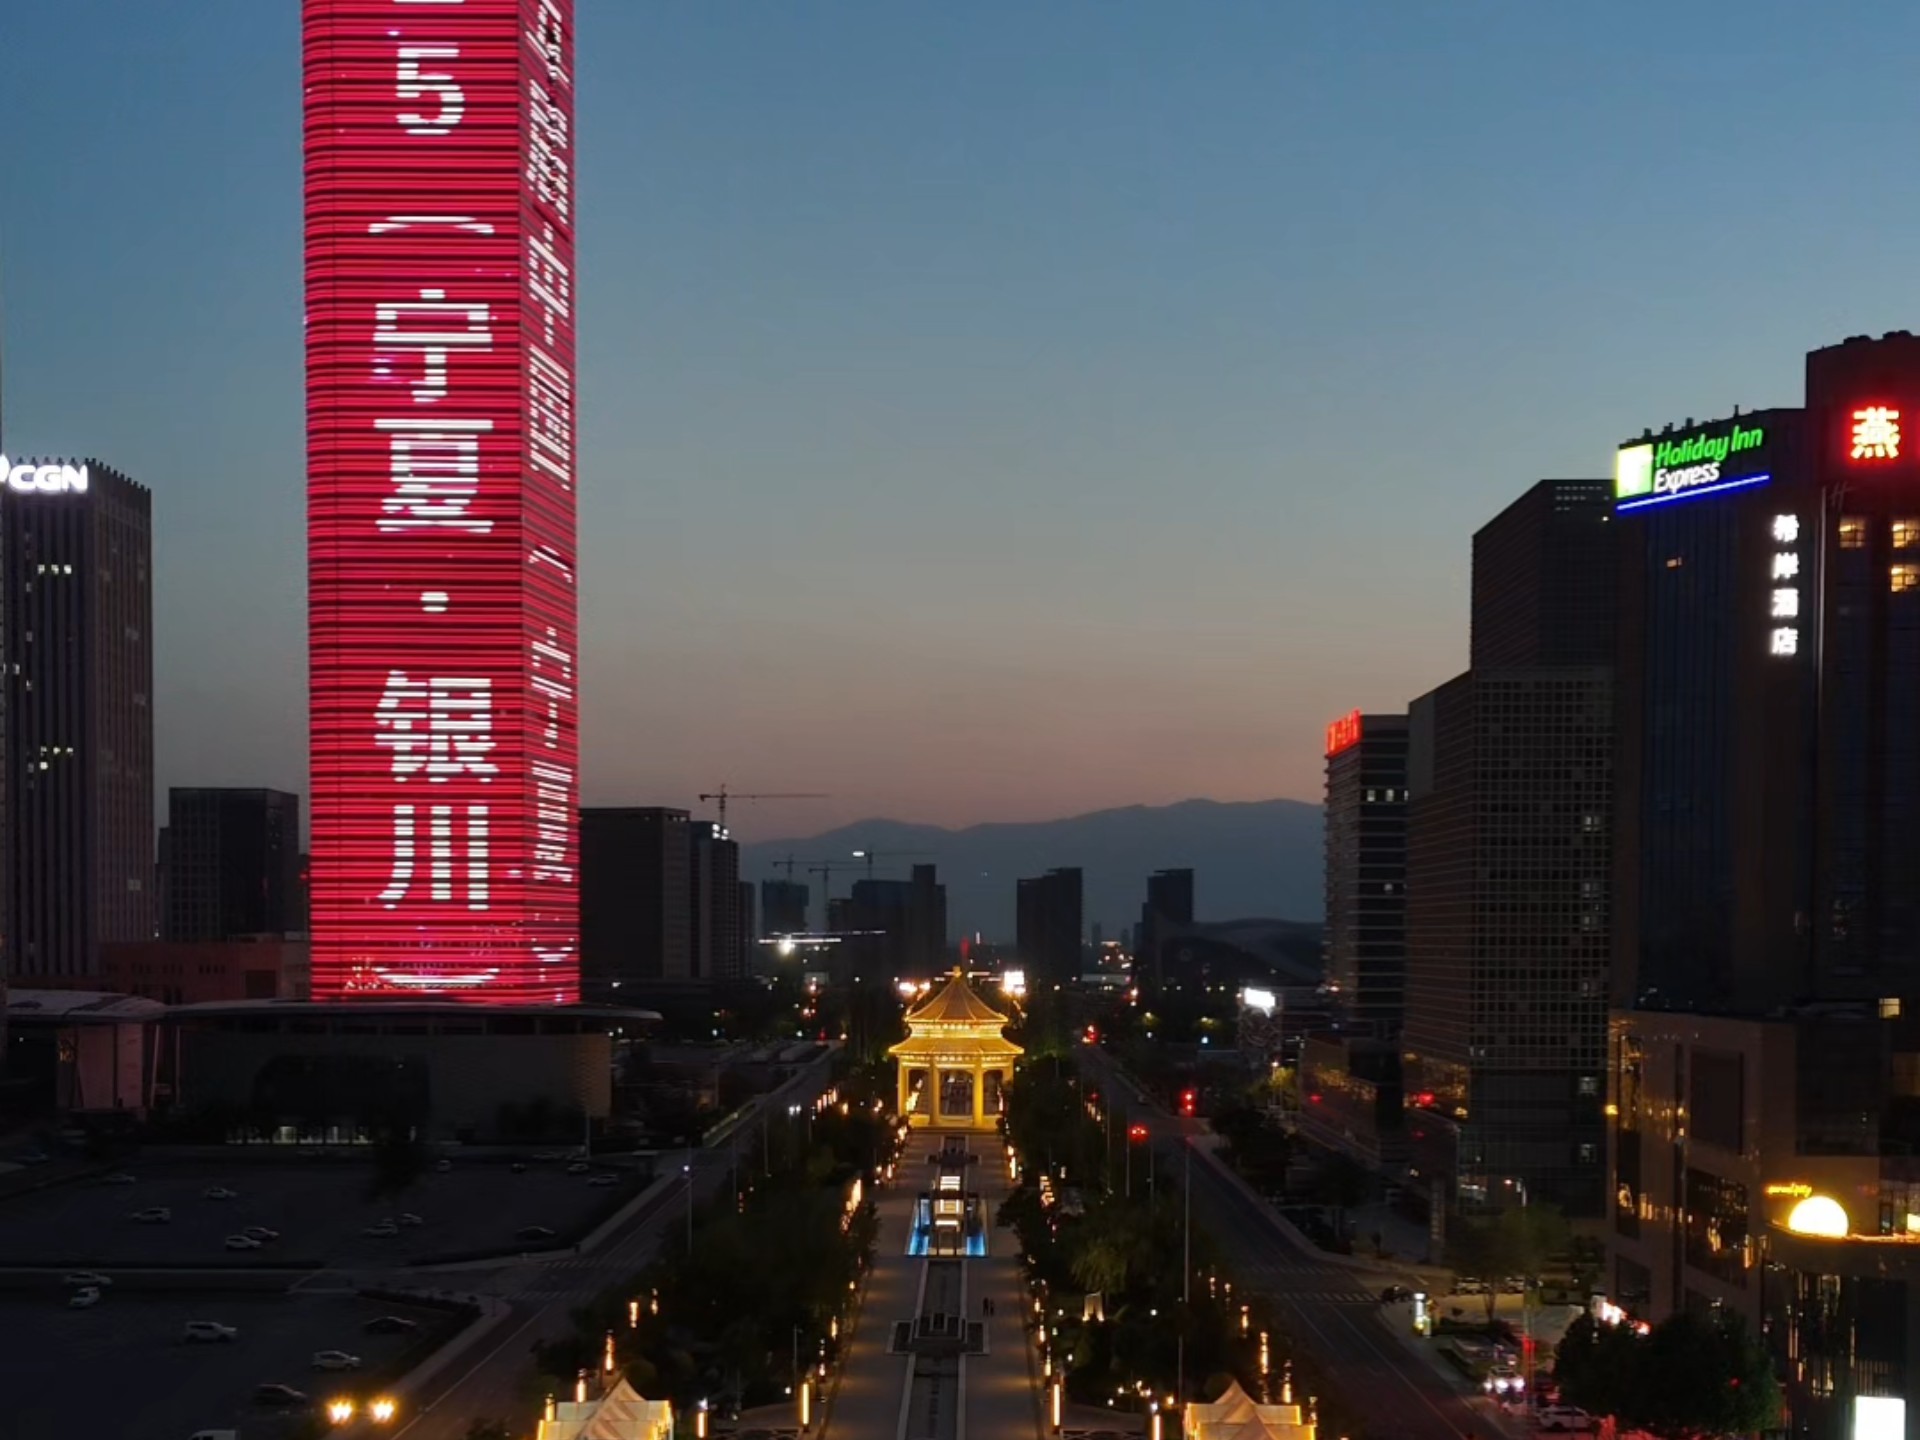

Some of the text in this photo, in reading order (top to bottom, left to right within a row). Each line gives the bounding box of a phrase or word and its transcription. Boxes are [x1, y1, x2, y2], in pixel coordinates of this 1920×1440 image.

[1656, 425, 1763, 468] Holiday Inn
[9, 464, 88, 492] CGN
[367, 0, 501, 985] 5（宁夏·银川）
[1653, 461, 1721, 494] Express
